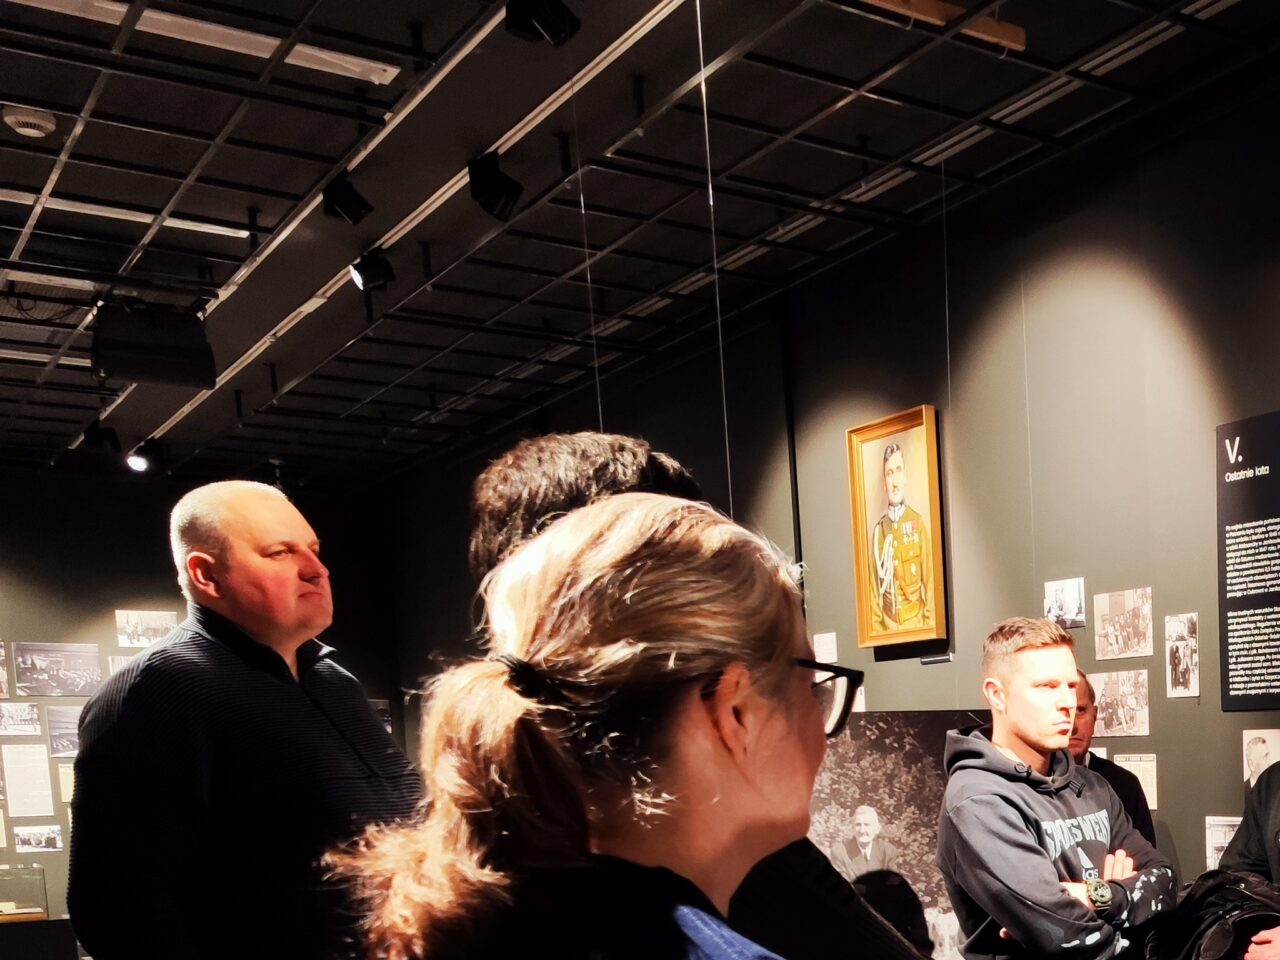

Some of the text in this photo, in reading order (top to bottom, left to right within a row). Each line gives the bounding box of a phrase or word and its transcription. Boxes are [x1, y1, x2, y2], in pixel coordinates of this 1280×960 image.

[1225, 436, 1243, 464] V.
[1225, 465, 1270, 482] Ostatnie lata
